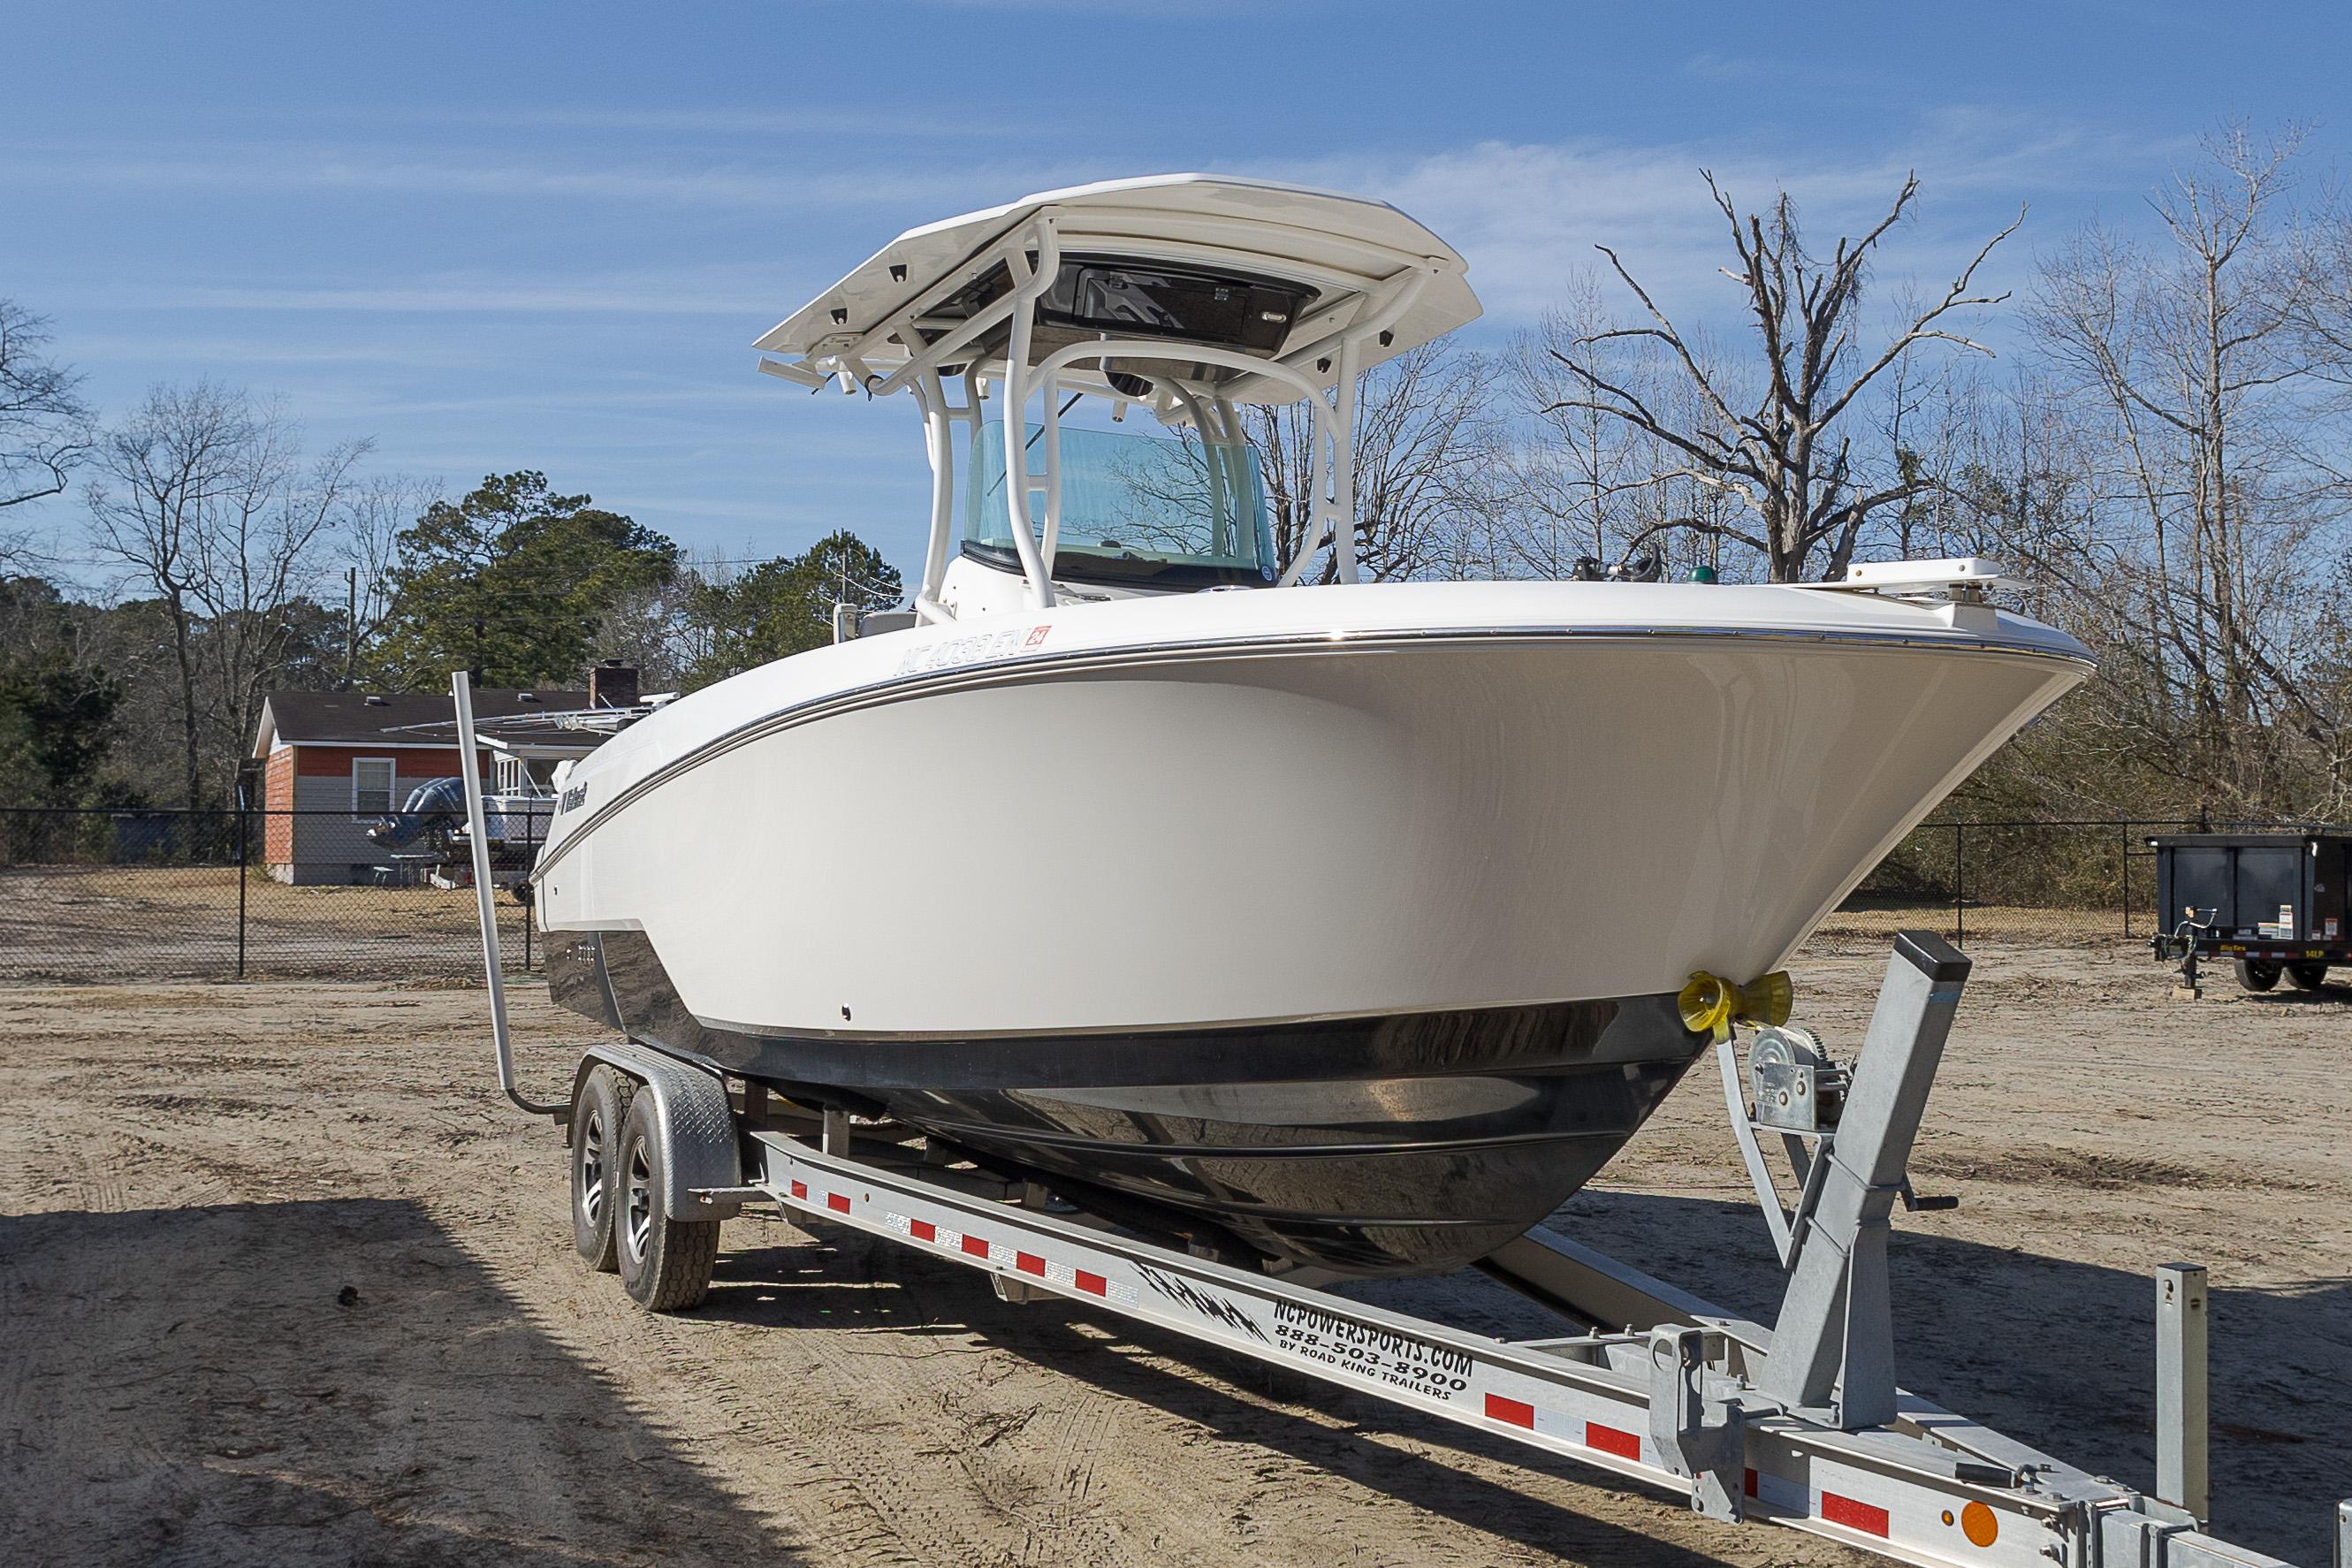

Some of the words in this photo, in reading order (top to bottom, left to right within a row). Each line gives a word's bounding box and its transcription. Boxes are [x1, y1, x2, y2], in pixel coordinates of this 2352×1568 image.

[1274, 1298, 1473, 1377] NCPOWERSPORTS.COM
[1275, 1324, 1467, 1391] 888-503-8900
[1279, 1339, 1297, 1351] BY
[1300, 1345, 1336, 1364] ROAD
[1341, 1359, 1376, 1376] KING
[1382, 1371, 1451, 1400] TRAILERS
